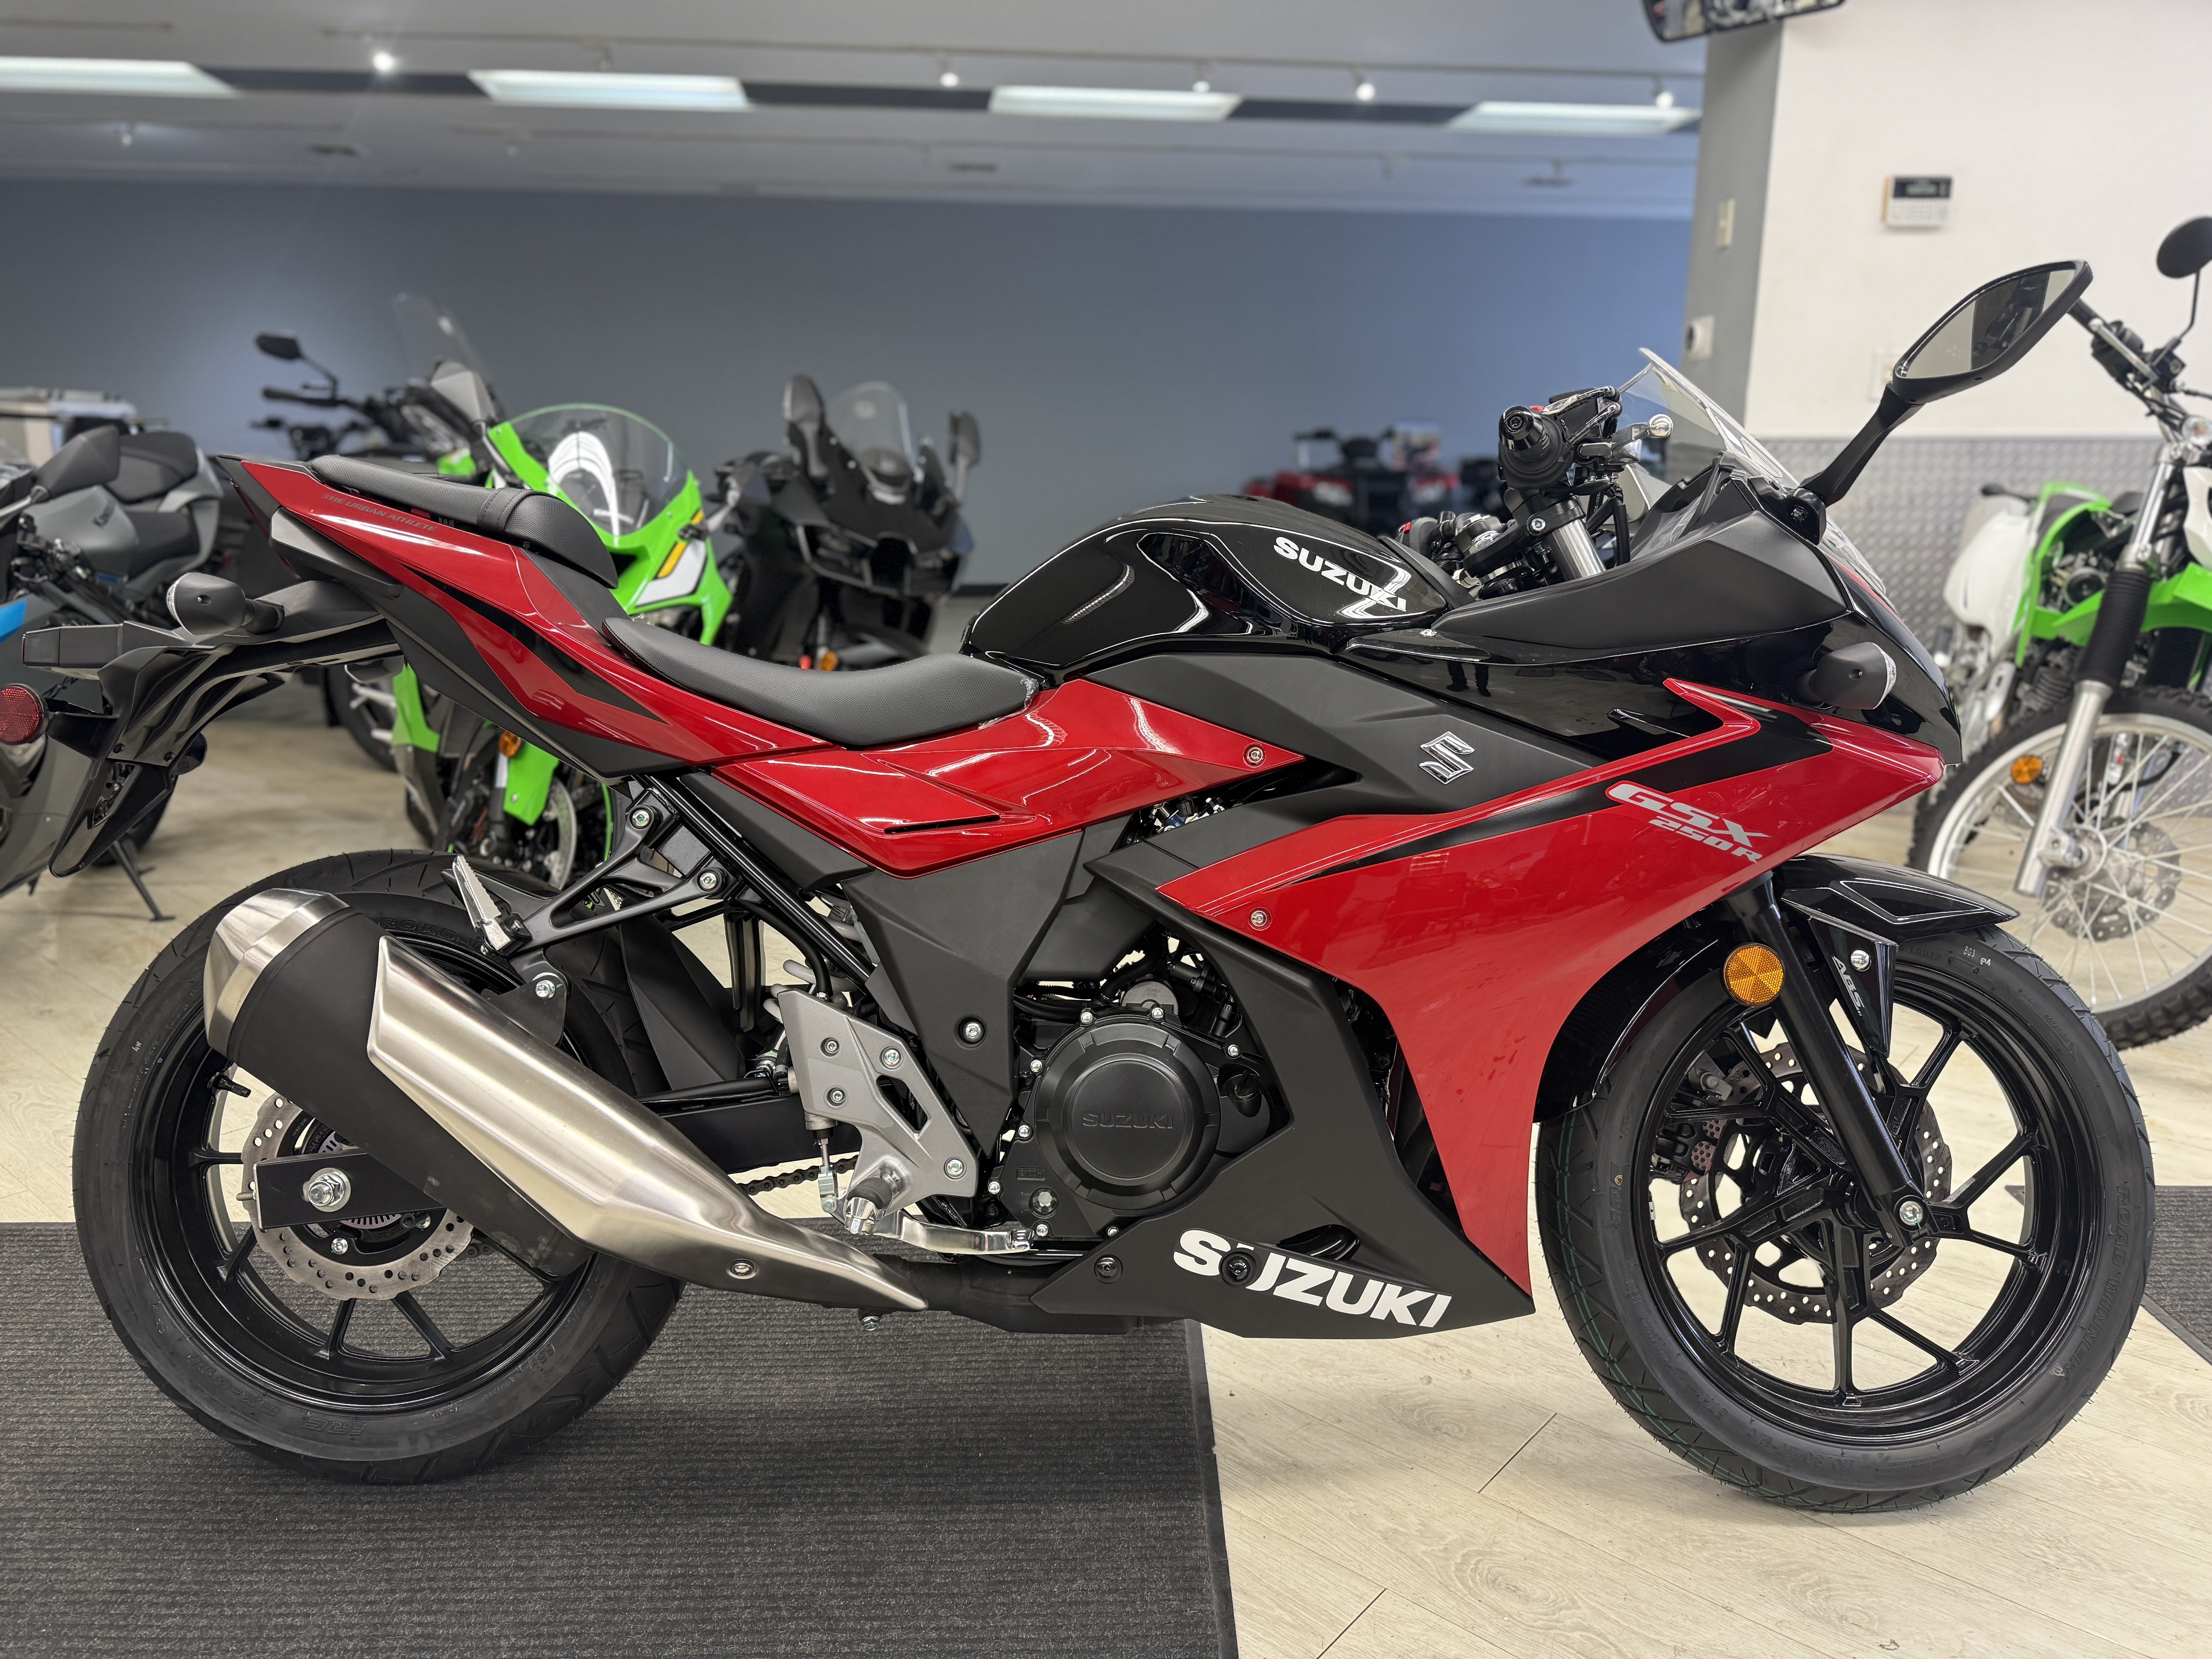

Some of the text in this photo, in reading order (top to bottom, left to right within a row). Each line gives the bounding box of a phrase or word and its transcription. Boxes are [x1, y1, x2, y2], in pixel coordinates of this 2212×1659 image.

[324, 495, 437, 531] THE URBAN ATHLETE
[1274, 536, 1407, 612] SUZUKI
[1609, 783, 1771, 847] GSX
[1963, 946, 1975, 957] BG3
[1980, 957, 1991, 966] P4
[1832, 956, 1865, 1009] ABS
[1082, 1112, 1173, 1129] SUZUKI
